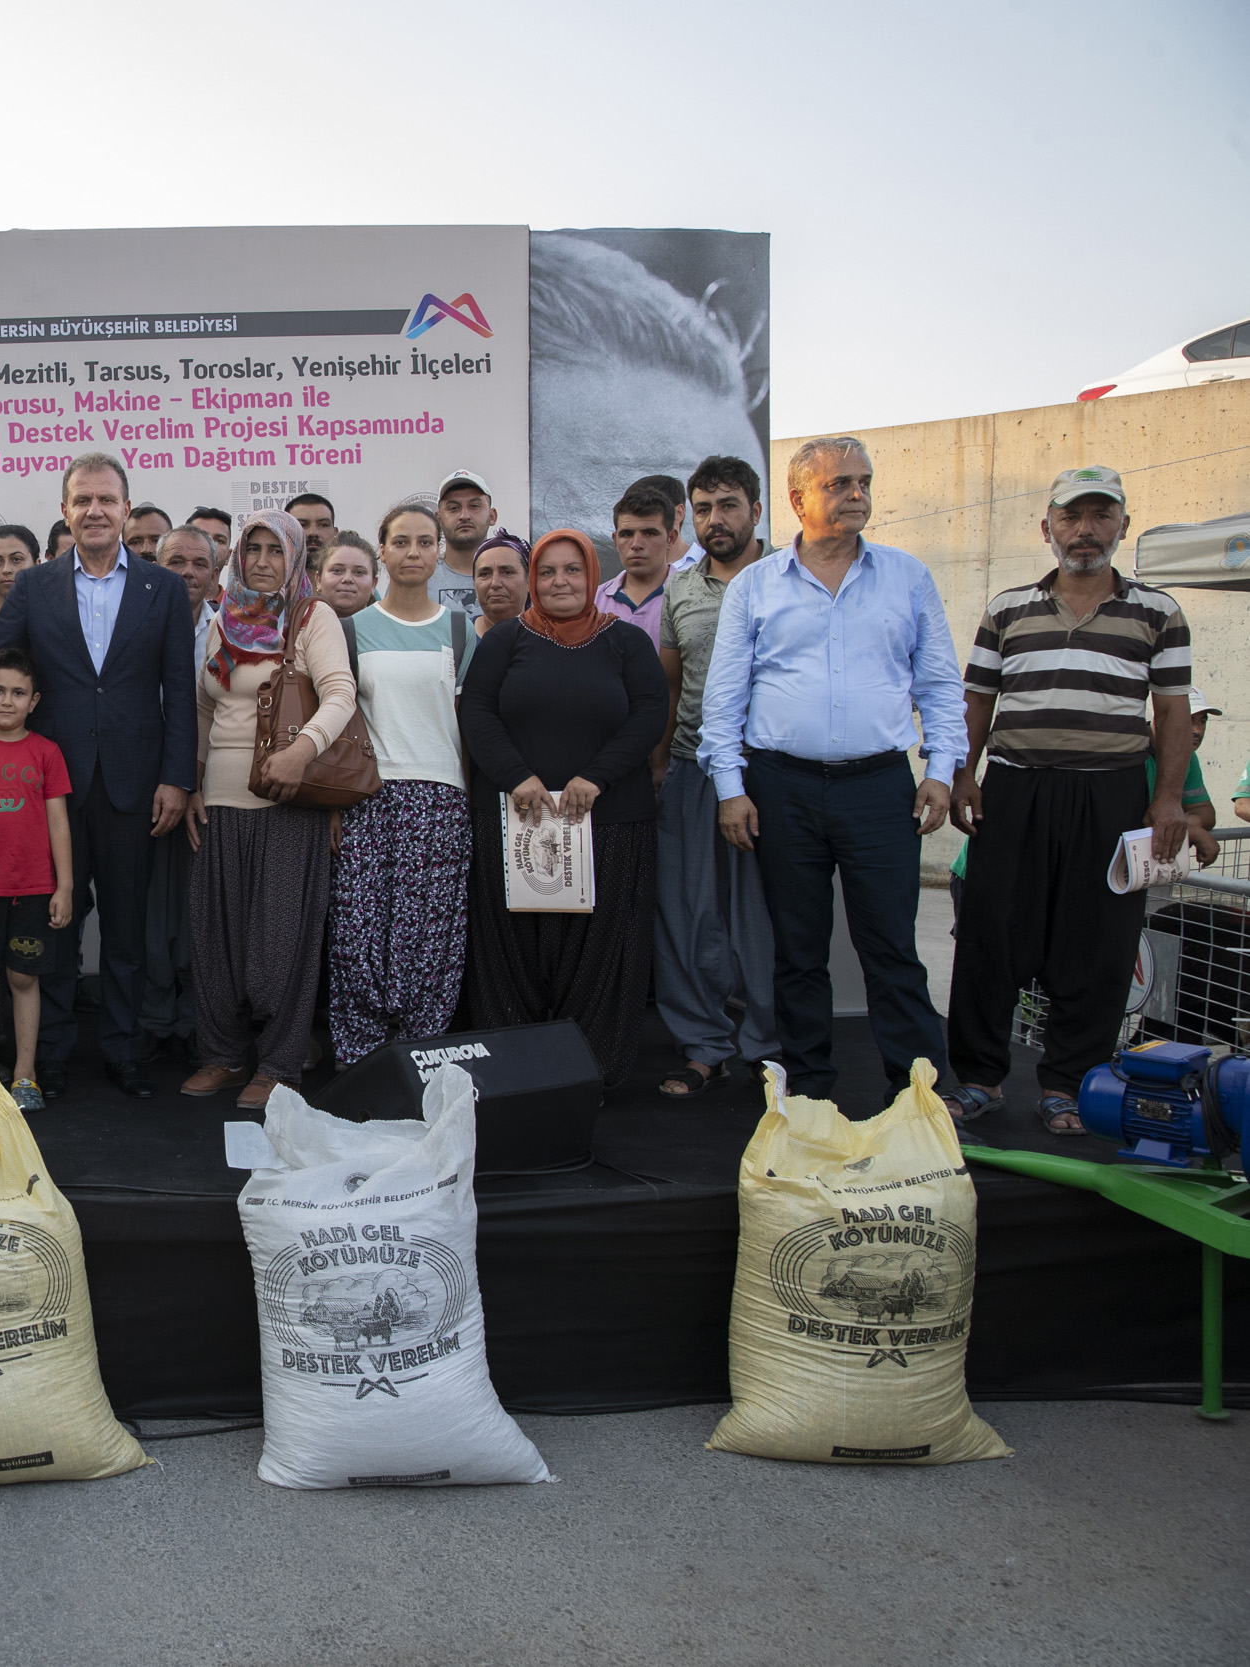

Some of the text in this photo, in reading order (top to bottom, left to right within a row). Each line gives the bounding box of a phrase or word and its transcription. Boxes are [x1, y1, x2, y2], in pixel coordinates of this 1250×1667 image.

[50, 317, 150, 338] BÜYÜKŞEHİR
[154, 315, 237, 333] BELEDİYESİ
[84, 360, 170, 385] Tarsus,
[179, 356, 284, 383] Toroslar,
[292, 353, 401, 382] Yenişehir
[411, 347, 492, 380] İlçeleri
[75, 389, 160, 413] Makine
[192, 387, 292, 415] Ekipman
[303, 386, 330, 407] ile
[9, 419, 93, 443] Destek
[103, 417, 193, 441] Verelim
[204, 415, 288, 443] Projesi
[298, 411, 444, 440] Kapsamında
[121, 447, 174, 469] Yem
[184, 446, 276, 473] Dağıtım
[286, 442, 361, 466] Töreni
[250, 480, 308, 494] DESTEK
[515, 833, 523, 847] GEL
[563, 855, 572, 887] DESTEK
[410, 1043, 491, 1069] ÇUKUROVA
[905, 1168, 952, 1186] BELEDİYESİ
[281, 1199, 319, 1210] MERSİN
[320, 1195, 381, 1210] BÜYÜKŞEHİR
[384, 1185, 434, 1202] BELEDİYESİ
[841, 1204, 935, 1225] HADİ GEL
[299, 1223, 404, 1249] HADİ GEL
[828, 1223, 947, 1253] KÖYÜMÜZE
[297, 1243, 421, 1276] KÖYÜMÜZE
[788, 1313, 967, 1346] DESTEK VERELİM
[282, 1332, 461, 1374] DESTEK VERELİM
